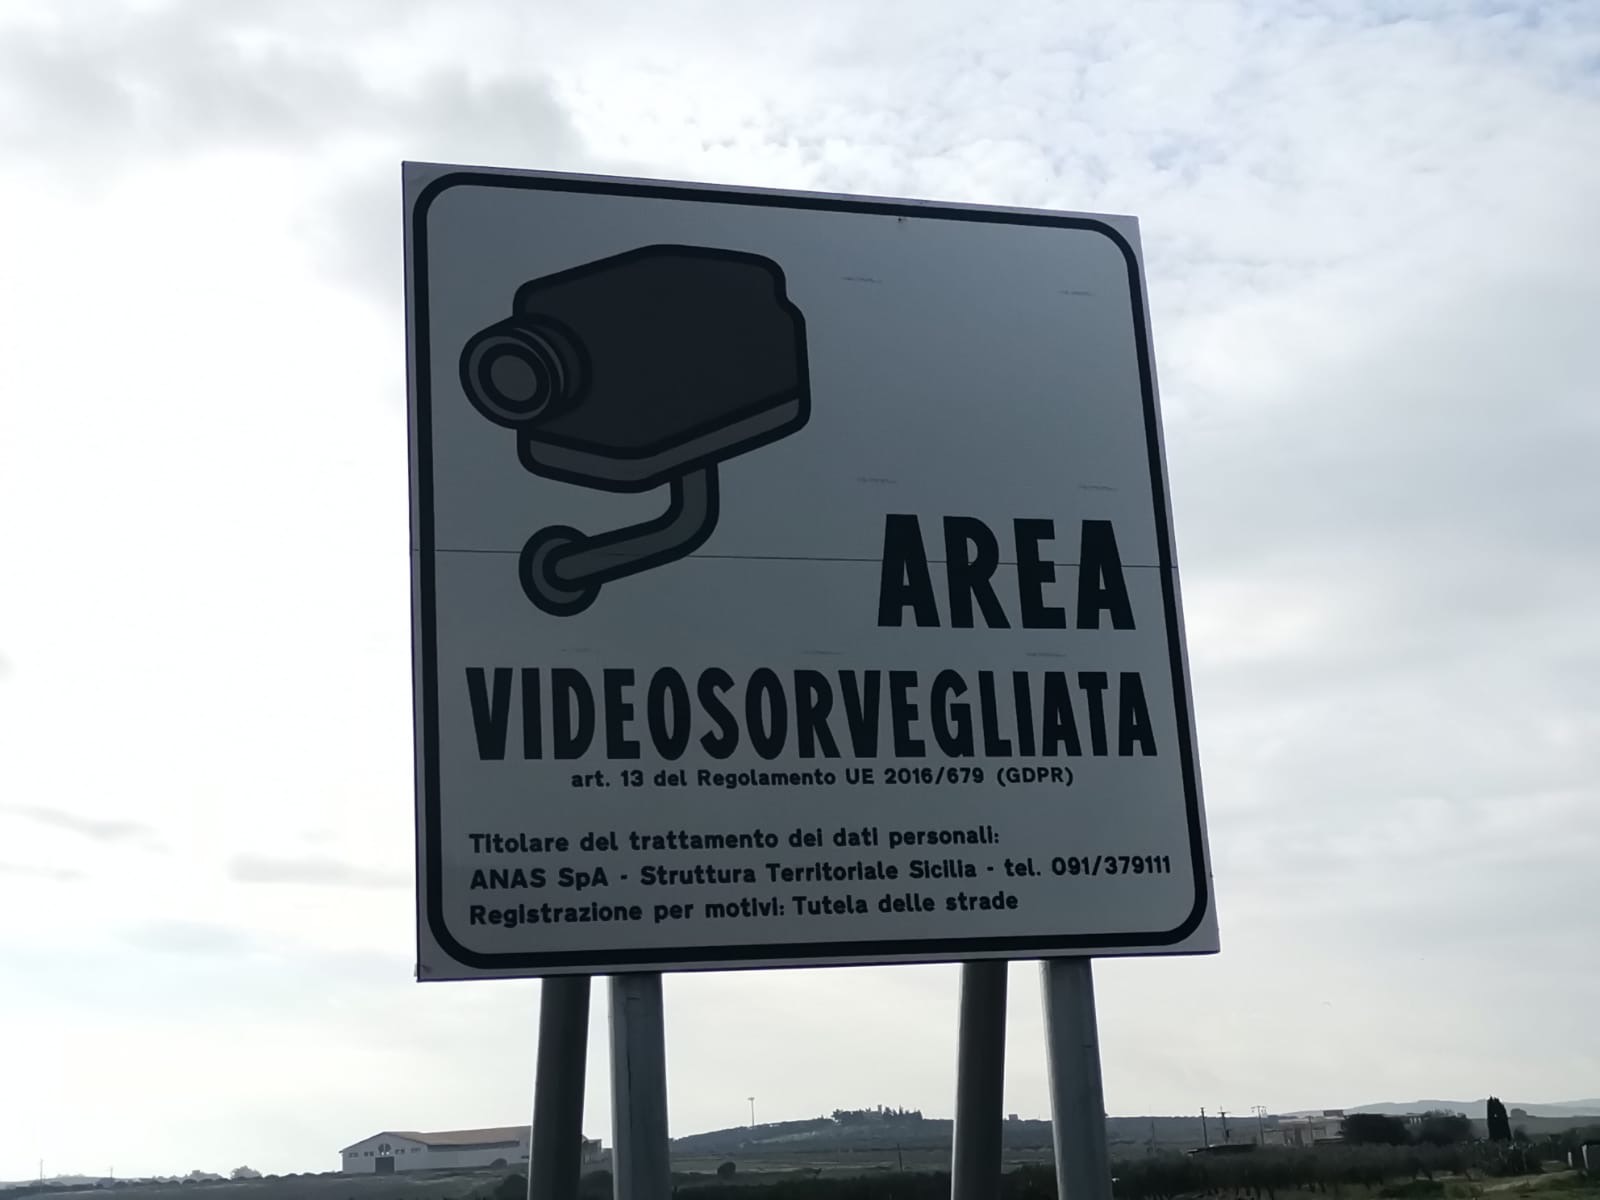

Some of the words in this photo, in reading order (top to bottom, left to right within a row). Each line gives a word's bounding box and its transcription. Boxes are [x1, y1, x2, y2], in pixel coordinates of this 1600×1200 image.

[878, 514, 1136, 629] AREA
[466, 667, 1157, 760] VIDEOSORVEGLIATA
[572, 770, 610, 787] art.
[621, 770, 643, 787] 13
[654, 770, 687, 786] del
[698, 768, 836, 789] Regolamento
[846, 768, 874, 784] UE
[884, 767, 984, 784] 2016/679
[997, 767, 1073, 787] (GDPR)
[469, 833, 569, 853] Titolare
[580, 832, 618, 851] del
[629, 829, 778, 850] trattamento
[789, 828, 822, 847] dei
[833, 827, 878, 846] dati
[889, 825, 999, 849] personali:
[470, 868, 546, 890] ANAS
[558, 867, 608, 891] SpA
[641, 865, 756, 885] Struttura
[766, 861, 898, 882] Territoriale
[909, 859, 977, 878] Sicilia
[1004, 858, 1041, 876] tel.
[1052, 856, 1170, 876] 091/379111
[470, 902, 642, 928] Registrazione
[654, 904, 693, 923] per
[705, 897, 784, 918] motivi:
[792, 895, 868, 915] Tutela
[878, 893, 935, 912] delle
[946, 891, 1018, 911] strade
